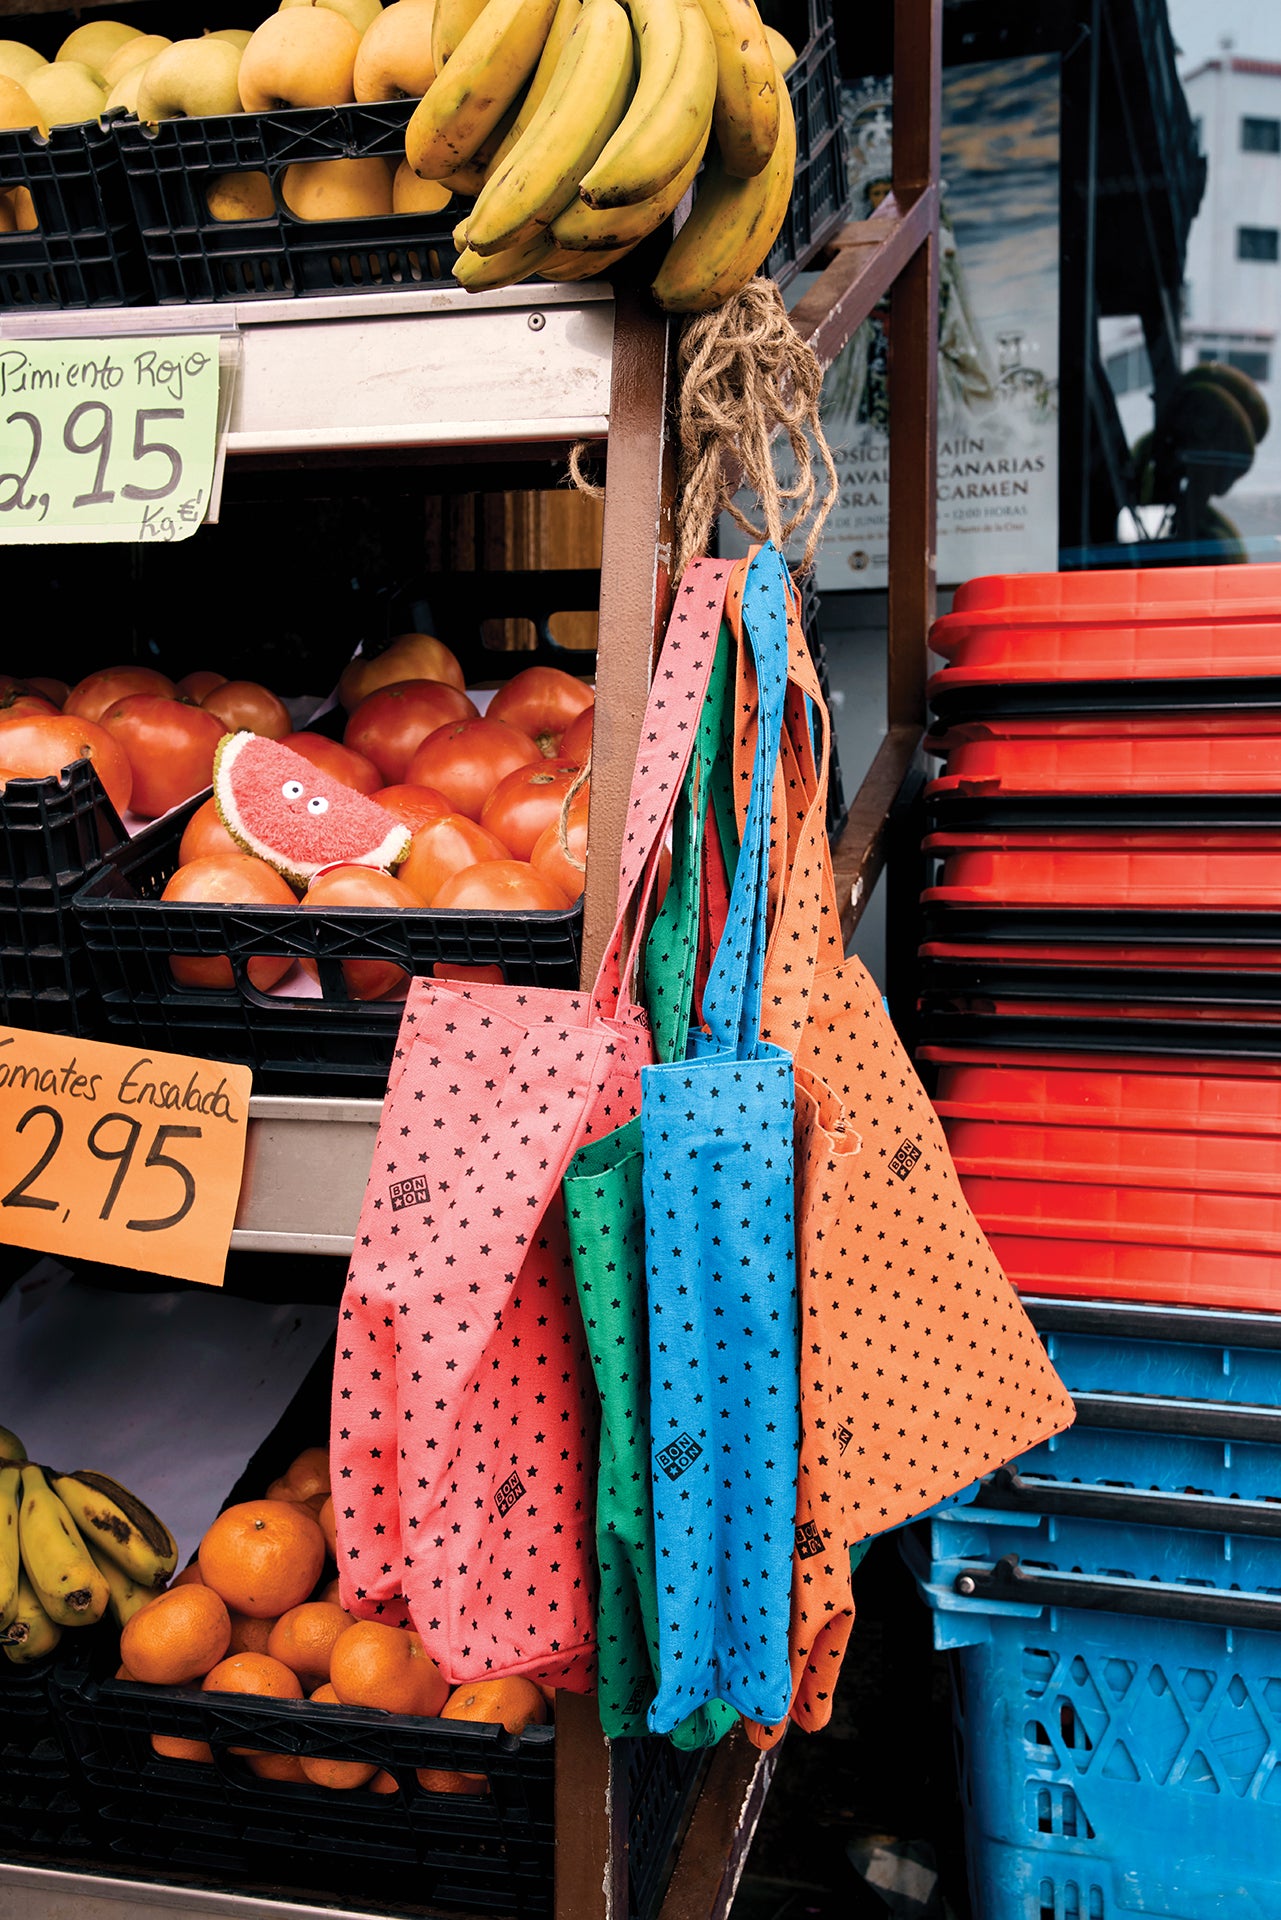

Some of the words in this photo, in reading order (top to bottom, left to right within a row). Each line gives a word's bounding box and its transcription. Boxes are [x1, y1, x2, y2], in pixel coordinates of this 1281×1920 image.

[0, 350, 123, 396] Pimiento
[134, 350, 211, 400] Rojo
[0, 401, 184, 521] 2,95
[937, 456, 1045, 479] CANARIAS
[937, 481, 1029, 501] CARMEN
[118, 1058, 239, 1123] Ensalada
[2, 1105, 202, 1232] 2,95
[891, 1142, 912, 1171] BON
[393, 1179, 424, 1196] BON
[659, 1437, 691, 1466] BON
[496, 1474, 518, 1503] BON
